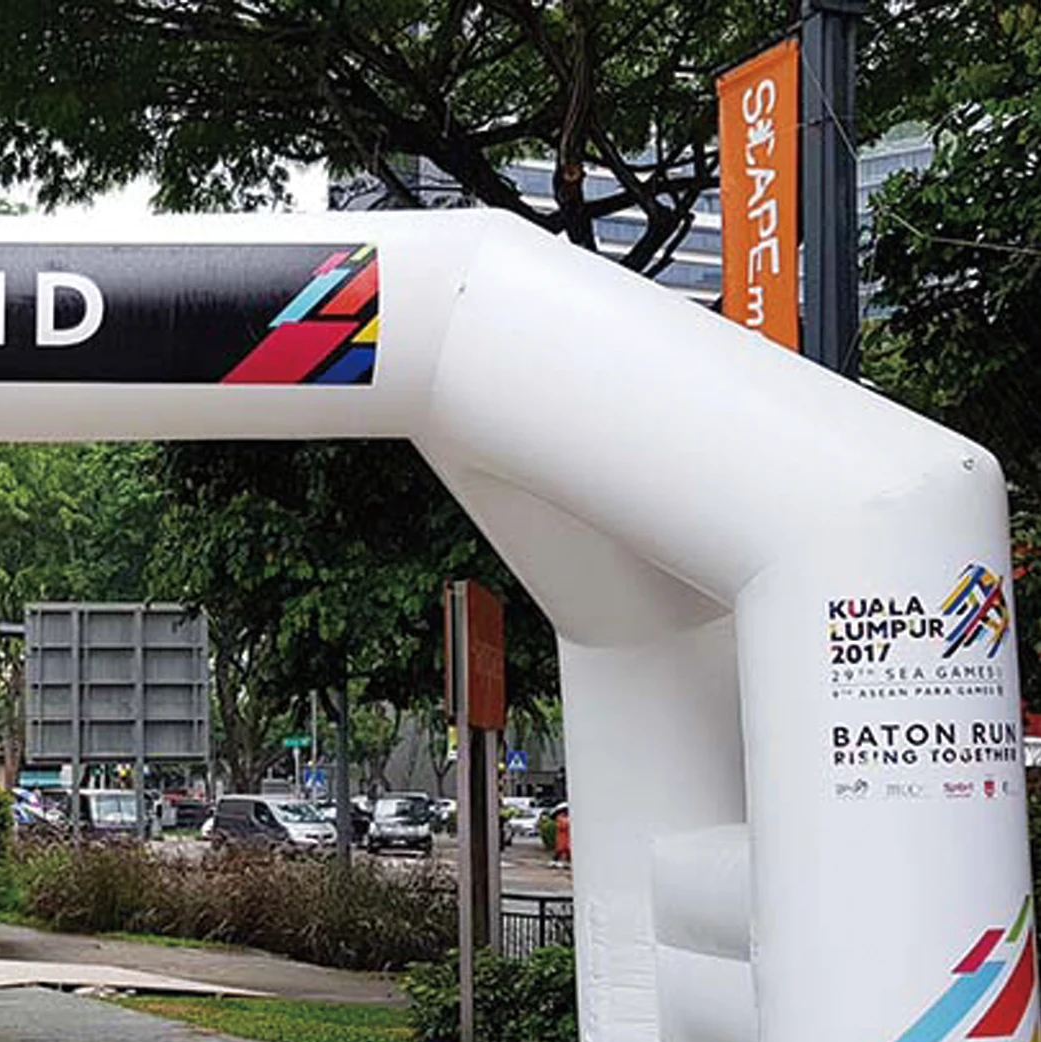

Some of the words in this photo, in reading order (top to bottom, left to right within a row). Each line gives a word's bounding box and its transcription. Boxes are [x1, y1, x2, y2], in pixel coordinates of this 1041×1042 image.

[828, 595, 925, 620] KUALA
[829, 618, 945, 642] LUMPUR
[831, 642, 891, 664] 2017
[885, 666, 925, 681] SEA
[935, 665, 994, 680] GAMES
[832, 722, 956, 748] BATON
[972, 722, 1017, 745] RUN
[834, 749, 919, 765] RISING
